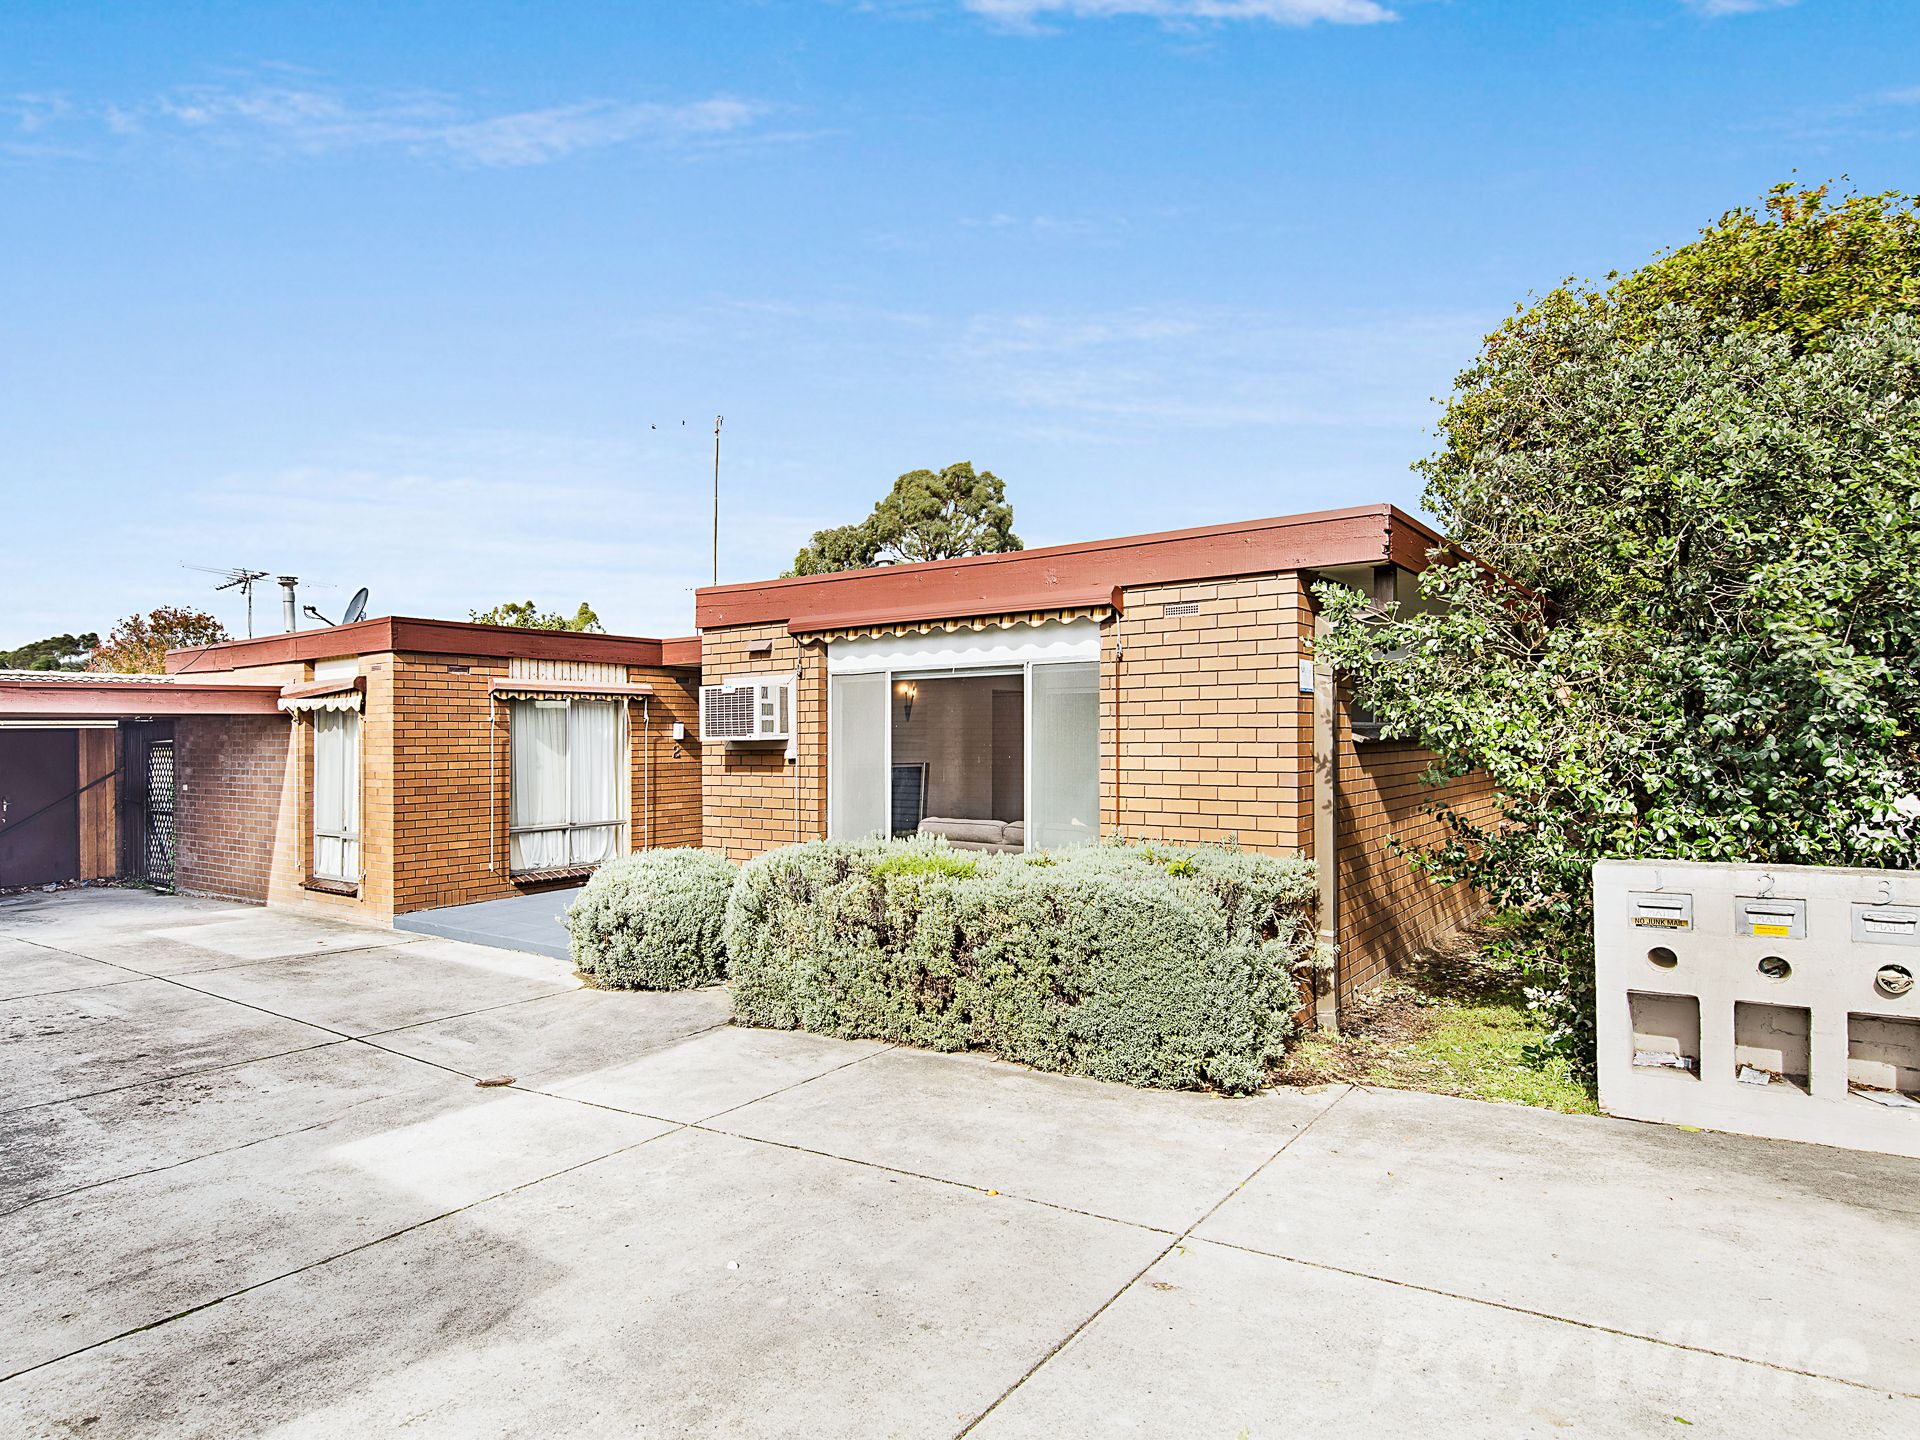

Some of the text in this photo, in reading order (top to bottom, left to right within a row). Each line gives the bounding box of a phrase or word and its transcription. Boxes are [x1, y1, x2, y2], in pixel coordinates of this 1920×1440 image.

[672, 745, 681, 759] 2
[1757, 873, 1776, 899] 2
[1873, 880, 1895, 906] 3
